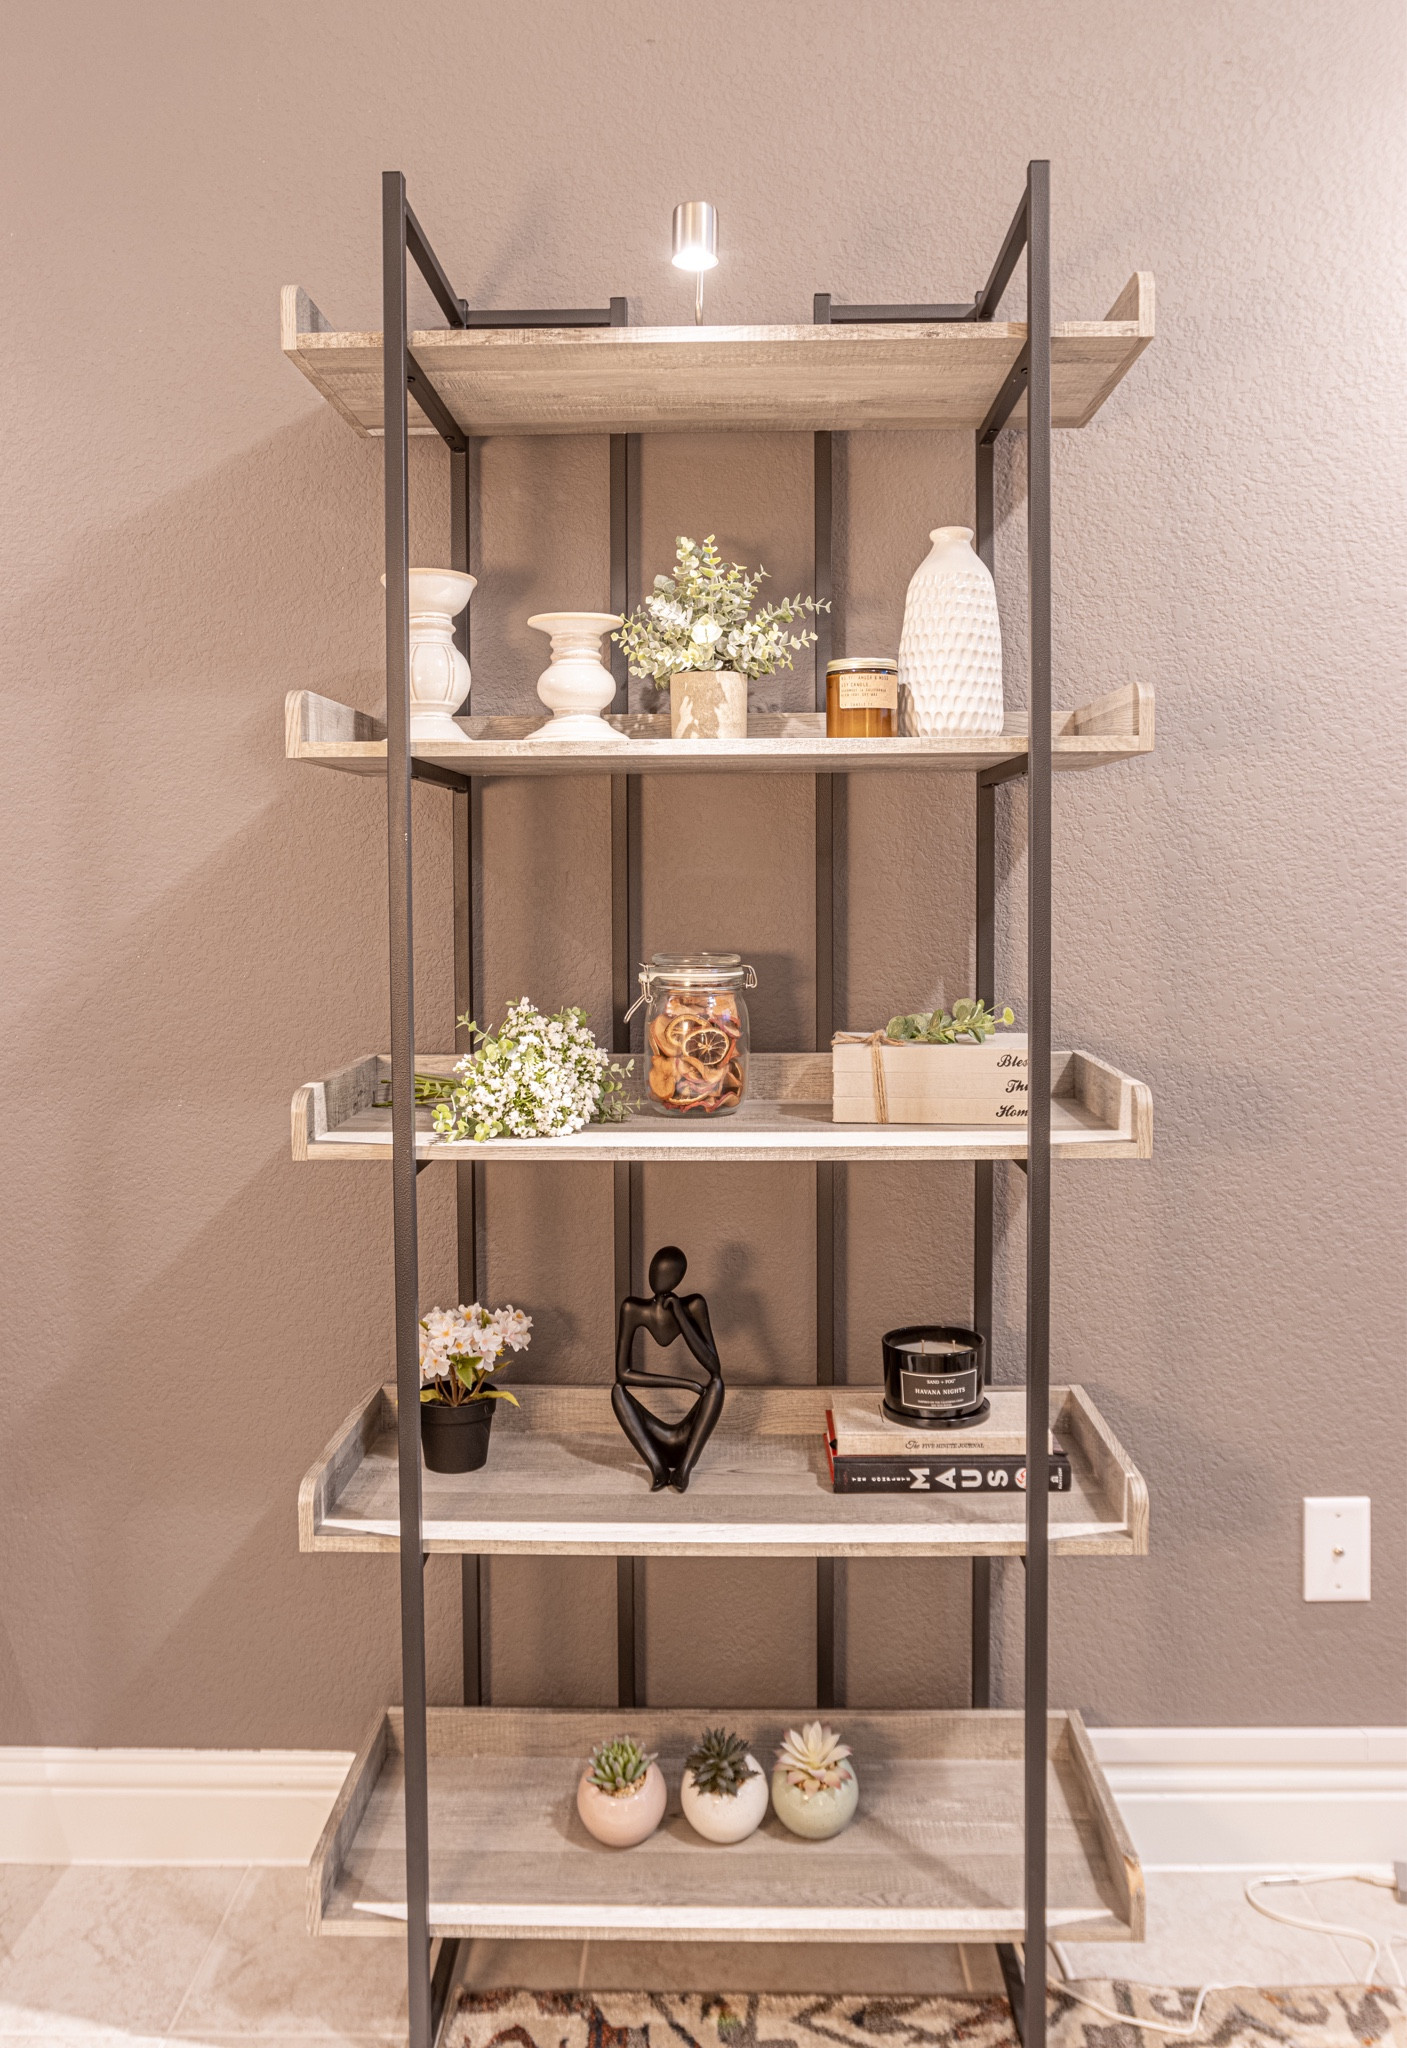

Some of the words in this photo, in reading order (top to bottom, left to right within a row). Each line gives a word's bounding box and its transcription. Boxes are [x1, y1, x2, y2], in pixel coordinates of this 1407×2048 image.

[914, 1387, 941, 1395] HAVANA
[942, 1386, 966, 1395] NIGHTS
[905, 1440, 920, 1450] The
[908, 1467, 1009, 1490] MAUS
